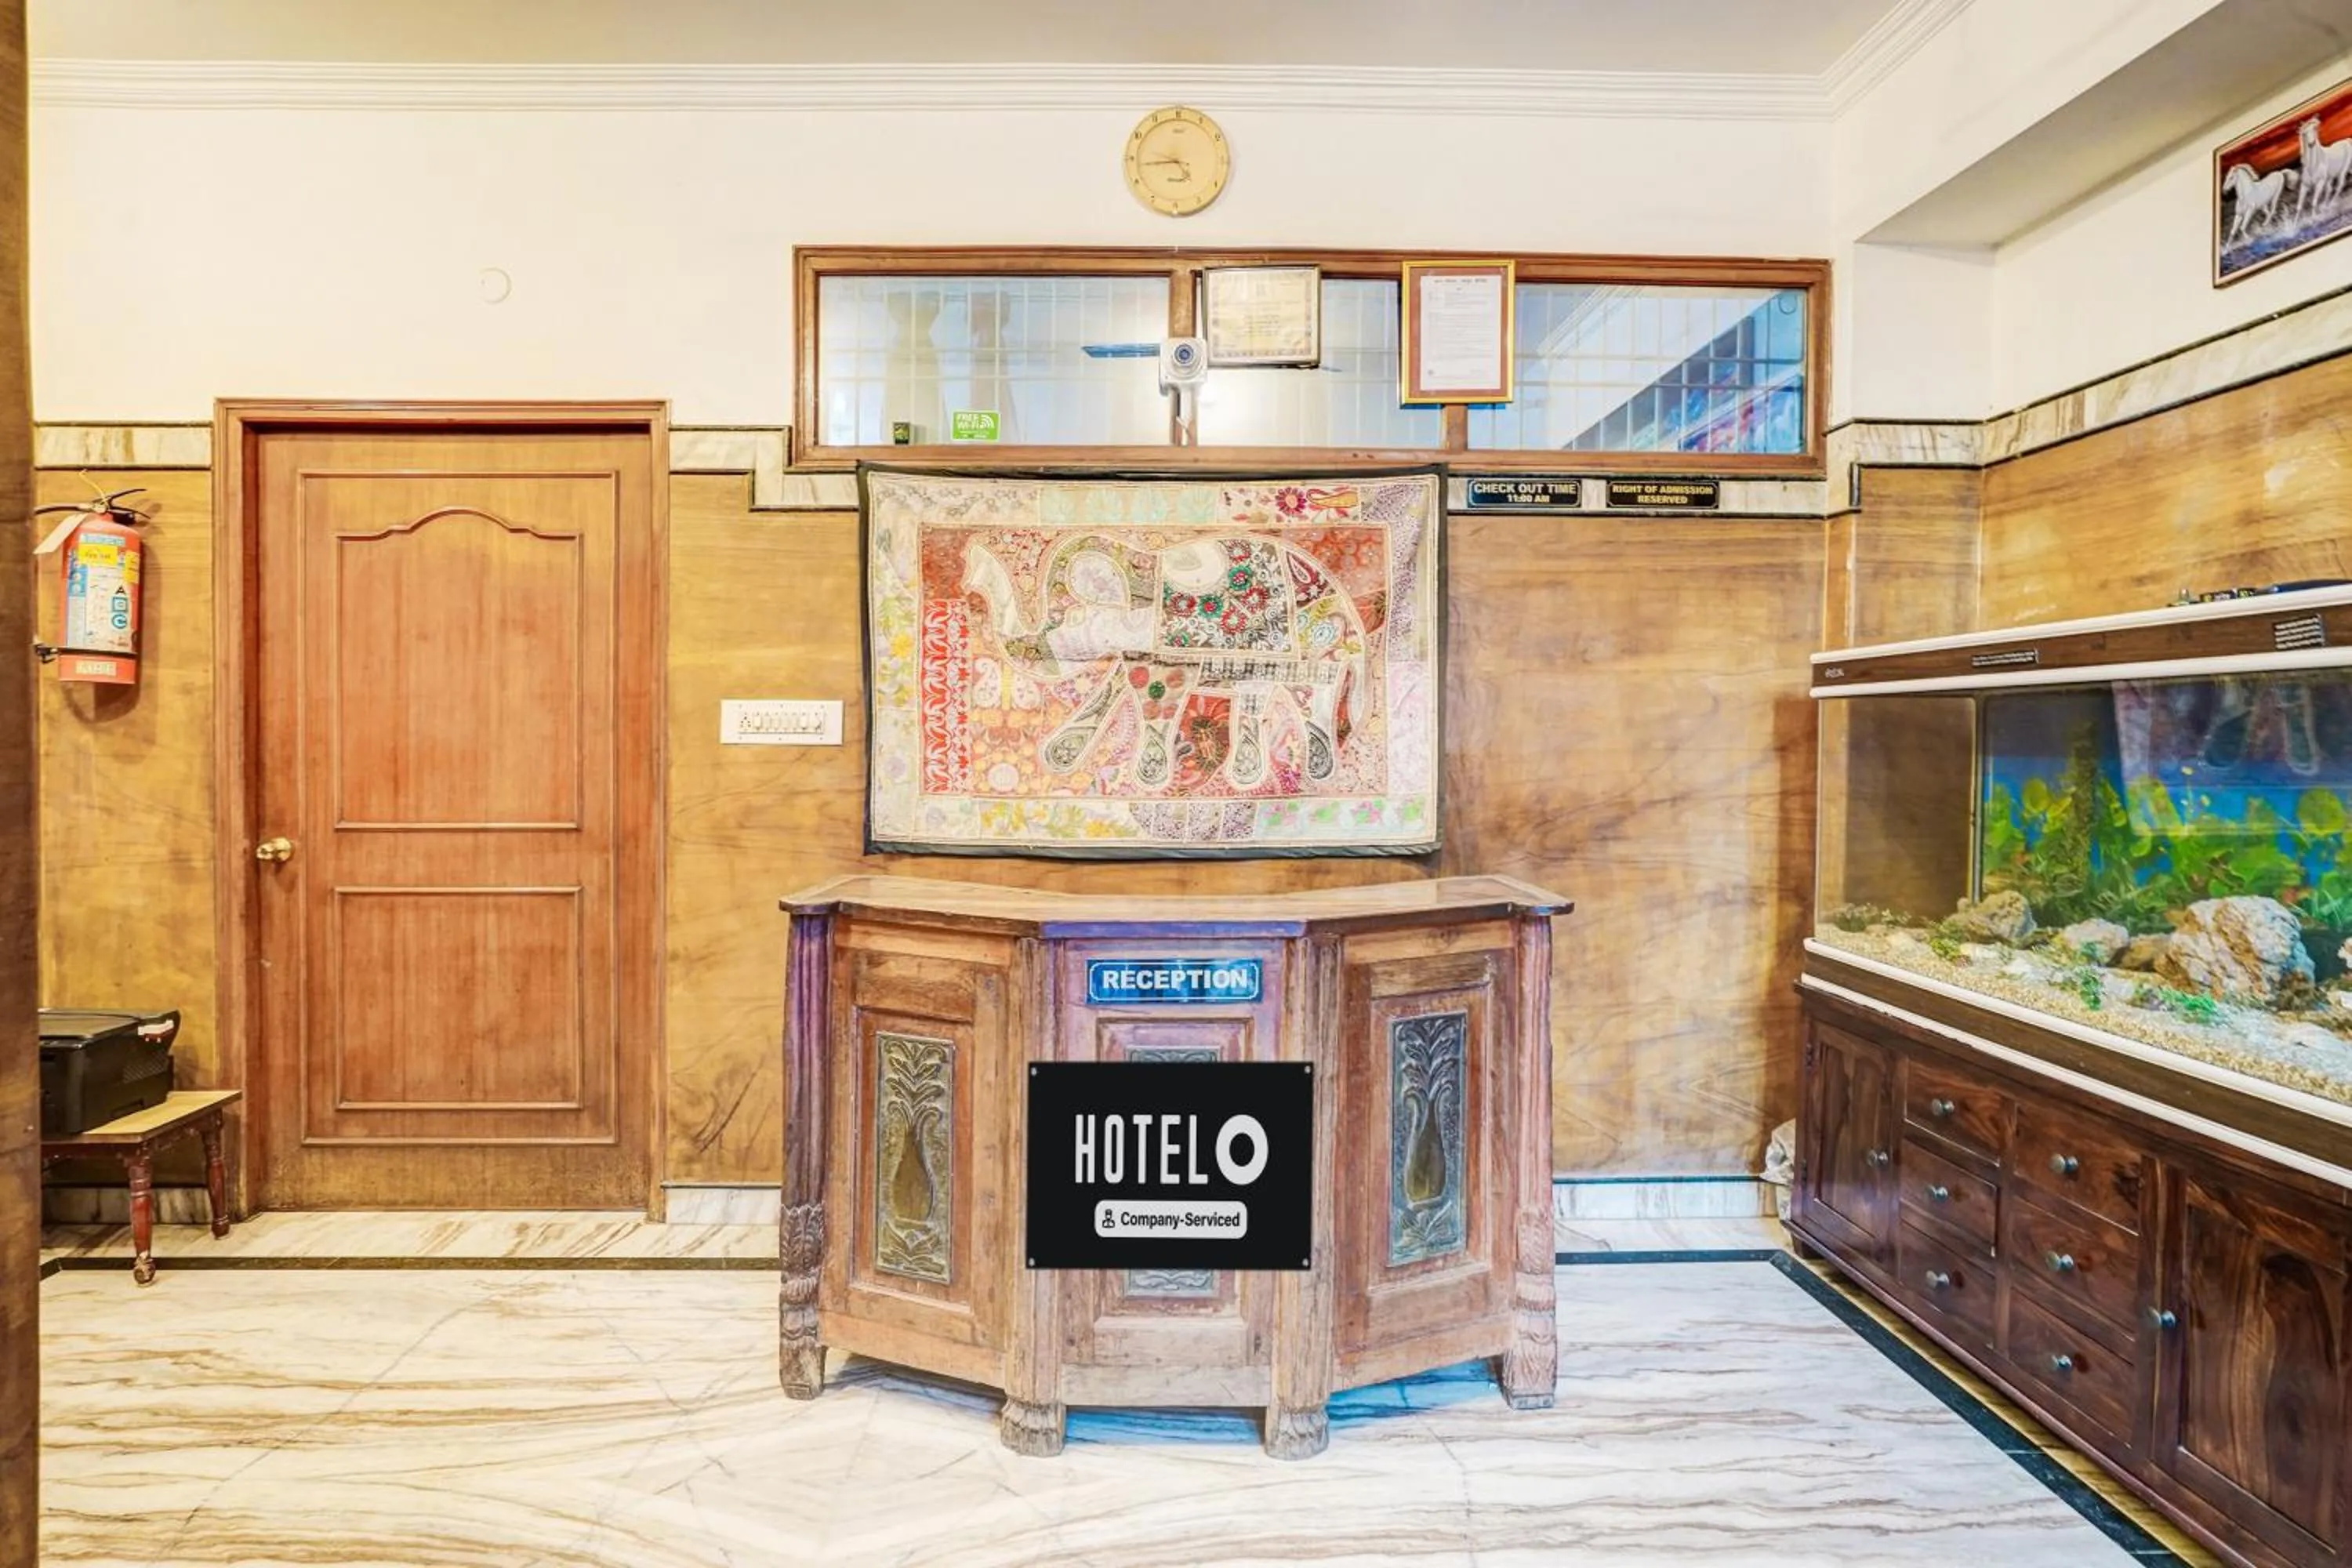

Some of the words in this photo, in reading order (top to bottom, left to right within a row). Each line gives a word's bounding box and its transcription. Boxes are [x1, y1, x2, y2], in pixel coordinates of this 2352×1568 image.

[1473, 484, 1515, 493] CHECK
[1518, 484, 1544, 493] OUT
[1547, 484, 1577, 494] TIME
[1612, 485, 1642, 493] RIGHT
[1637, 495, 1689, 504] RESERVED
[1102, 969, 1248, 990] RECEPTION
[1120, 1212, 1240, 1229] Company-Serviced
